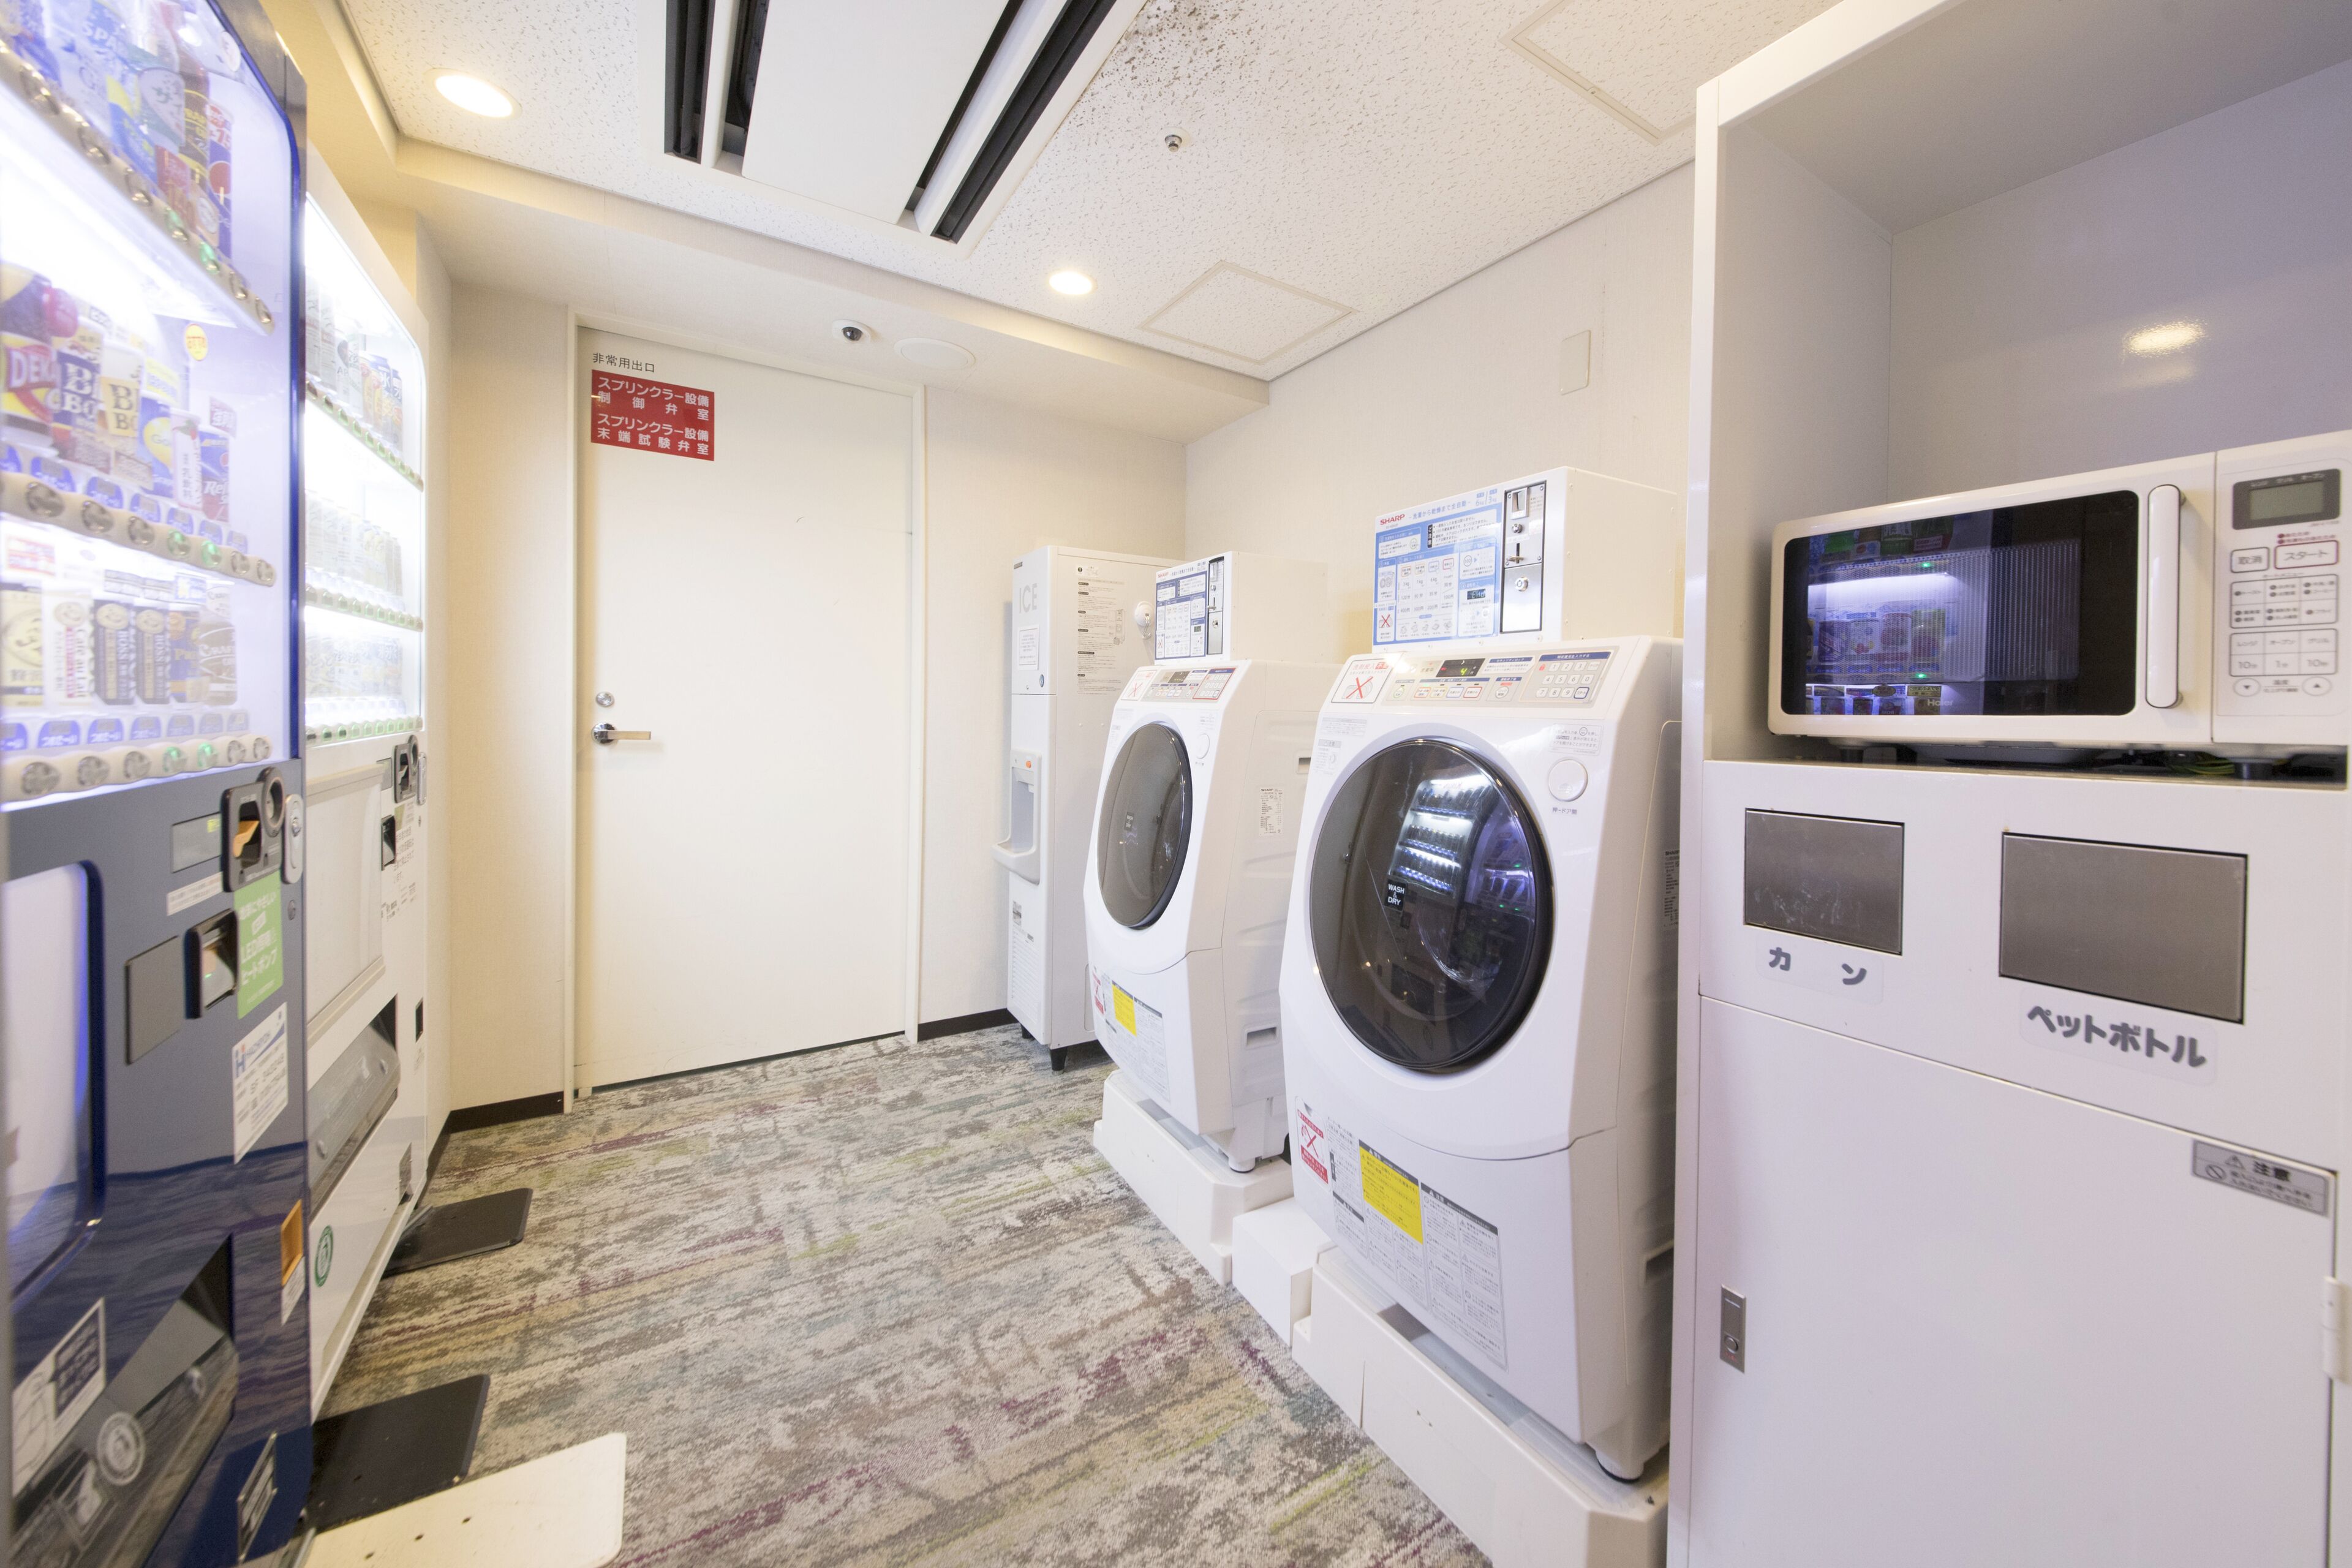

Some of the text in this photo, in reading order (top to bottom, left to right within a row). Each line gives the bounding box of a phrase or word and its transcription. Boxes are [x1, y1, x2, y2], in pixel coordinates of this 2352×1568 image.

[593, 353, 655, 372] 非常用出口
[598, 377, 709, 408] スプリンクラー設備
[598, 413, 709, 442] スプリンクラー設備
[598, 428, 709, 455] 末端試験弁室
[1380, 514, 1405, 525] SHARP
[2284, 549, 2329, 561] スタート
[1019, 583, 1038, 613] ICE
[1388, 883, 1405, 894] WASH
[1388, 896, 1401, 905] DRY
[1769, 947, 1867, 985] カン
[2027, 1006, 2207, 1068] ペットボトル
